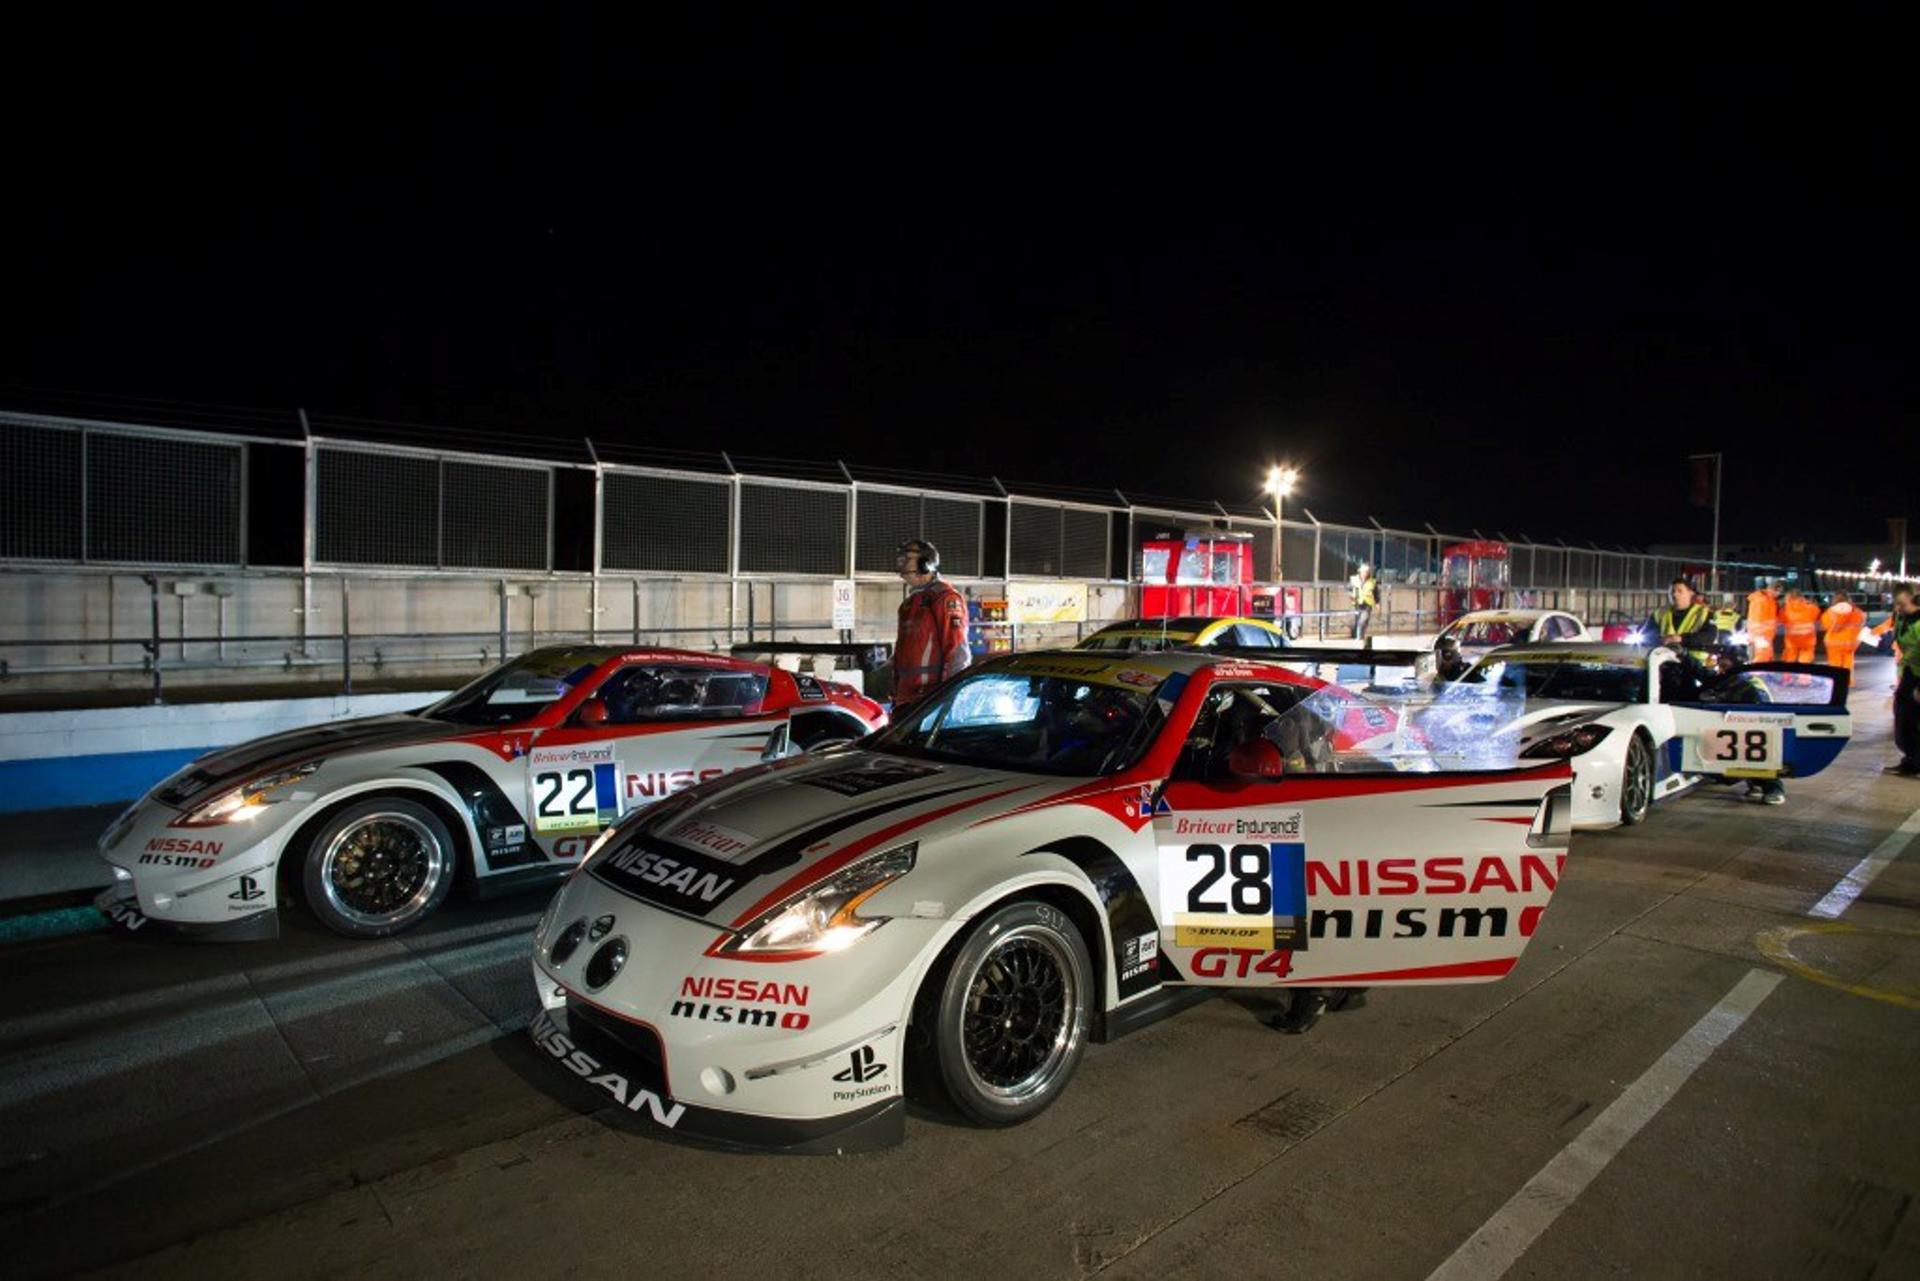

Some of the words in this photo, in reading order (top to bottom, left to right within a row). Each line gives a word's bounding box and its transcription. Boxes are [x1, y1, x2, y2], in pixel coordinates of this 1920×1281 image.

[1716, 730, 1767, 762] 38
[537, 769, 596, 817] 22
[1175, 818, 1235, 834] Britcar
[1236, 817, 1299, 834] Endurance
[138, 854, 216, 870] nismo
[144, 838, 224, 855] NISSAN
[608, 844, 736, 902] NISSAN
[1186, 843, 1272, 915] 28
[1305, 854, 1568, 897] NISSAN
[1197, 926, 1260, 938] DUNLOP
[1190, 947, 1294, 978] GT4
[681, 977, 809, 1006] NISSAN
[670, 1000, 810, 1031] nismo
[531, 1008, 686, 1129] NISSAN
[833, 1082, 892, 1101] PlayStation
